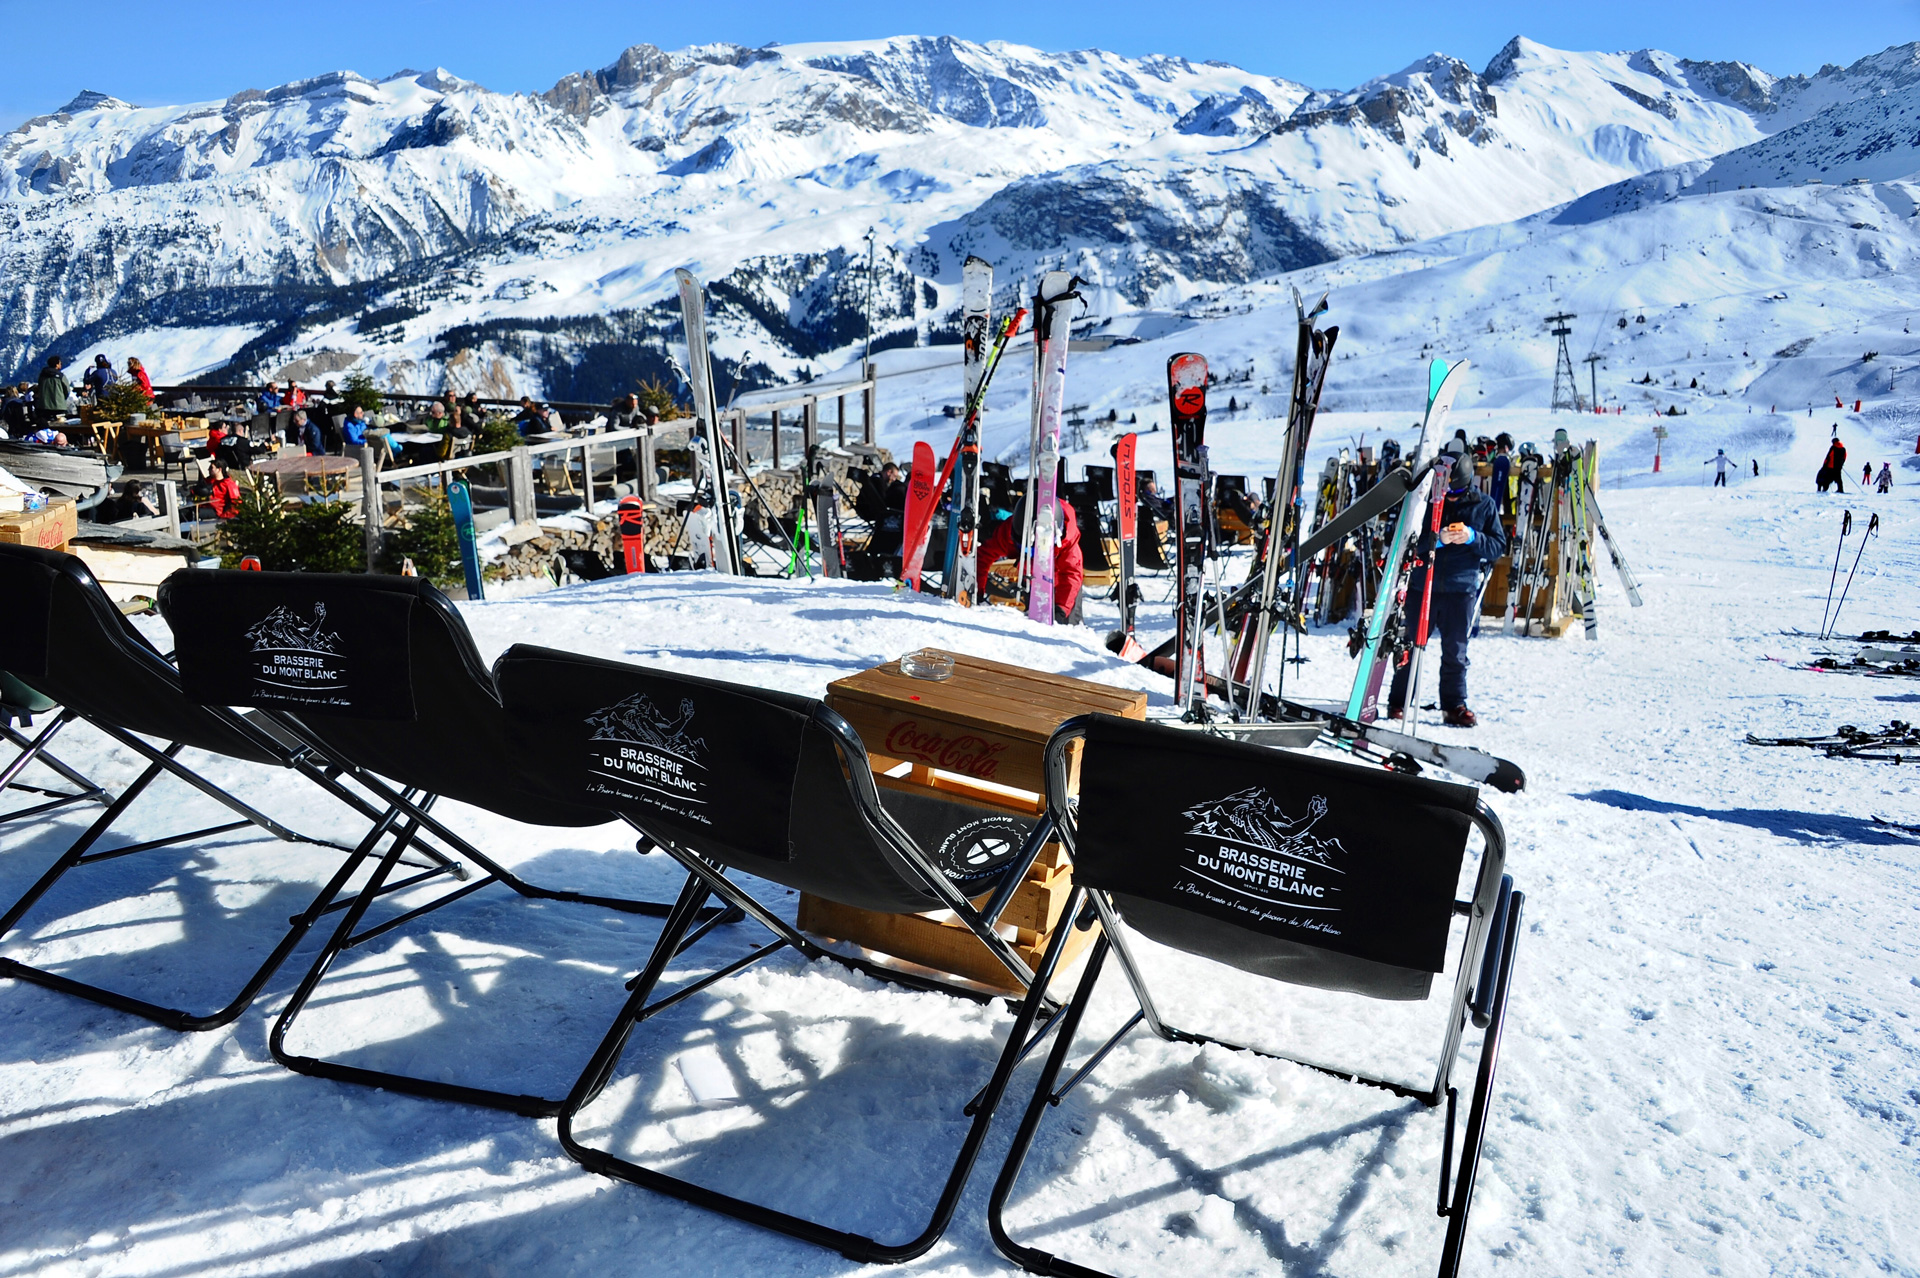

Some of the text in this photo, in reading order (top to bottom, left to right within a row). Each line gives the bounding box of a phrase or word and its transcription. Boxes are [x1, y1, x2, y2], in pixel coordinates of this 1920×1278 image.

[262, 665, 338, 680] DU MONT BLANC
[273, 654, 324, 668] BRASSERIE
[620, 747, 684, 776] BRASSERIE
[885, 720, 1010, 779] Coca-Cola
[603, 756, 698, 792] DU MONT BLANC
[956, 820, 980, 835] MONT
[938, 833, 956, 854] BLANC
[1197, 853, 1325, 898] DU MONT BLANC
[1218, 845, 1306, 880] BRASSERIE
